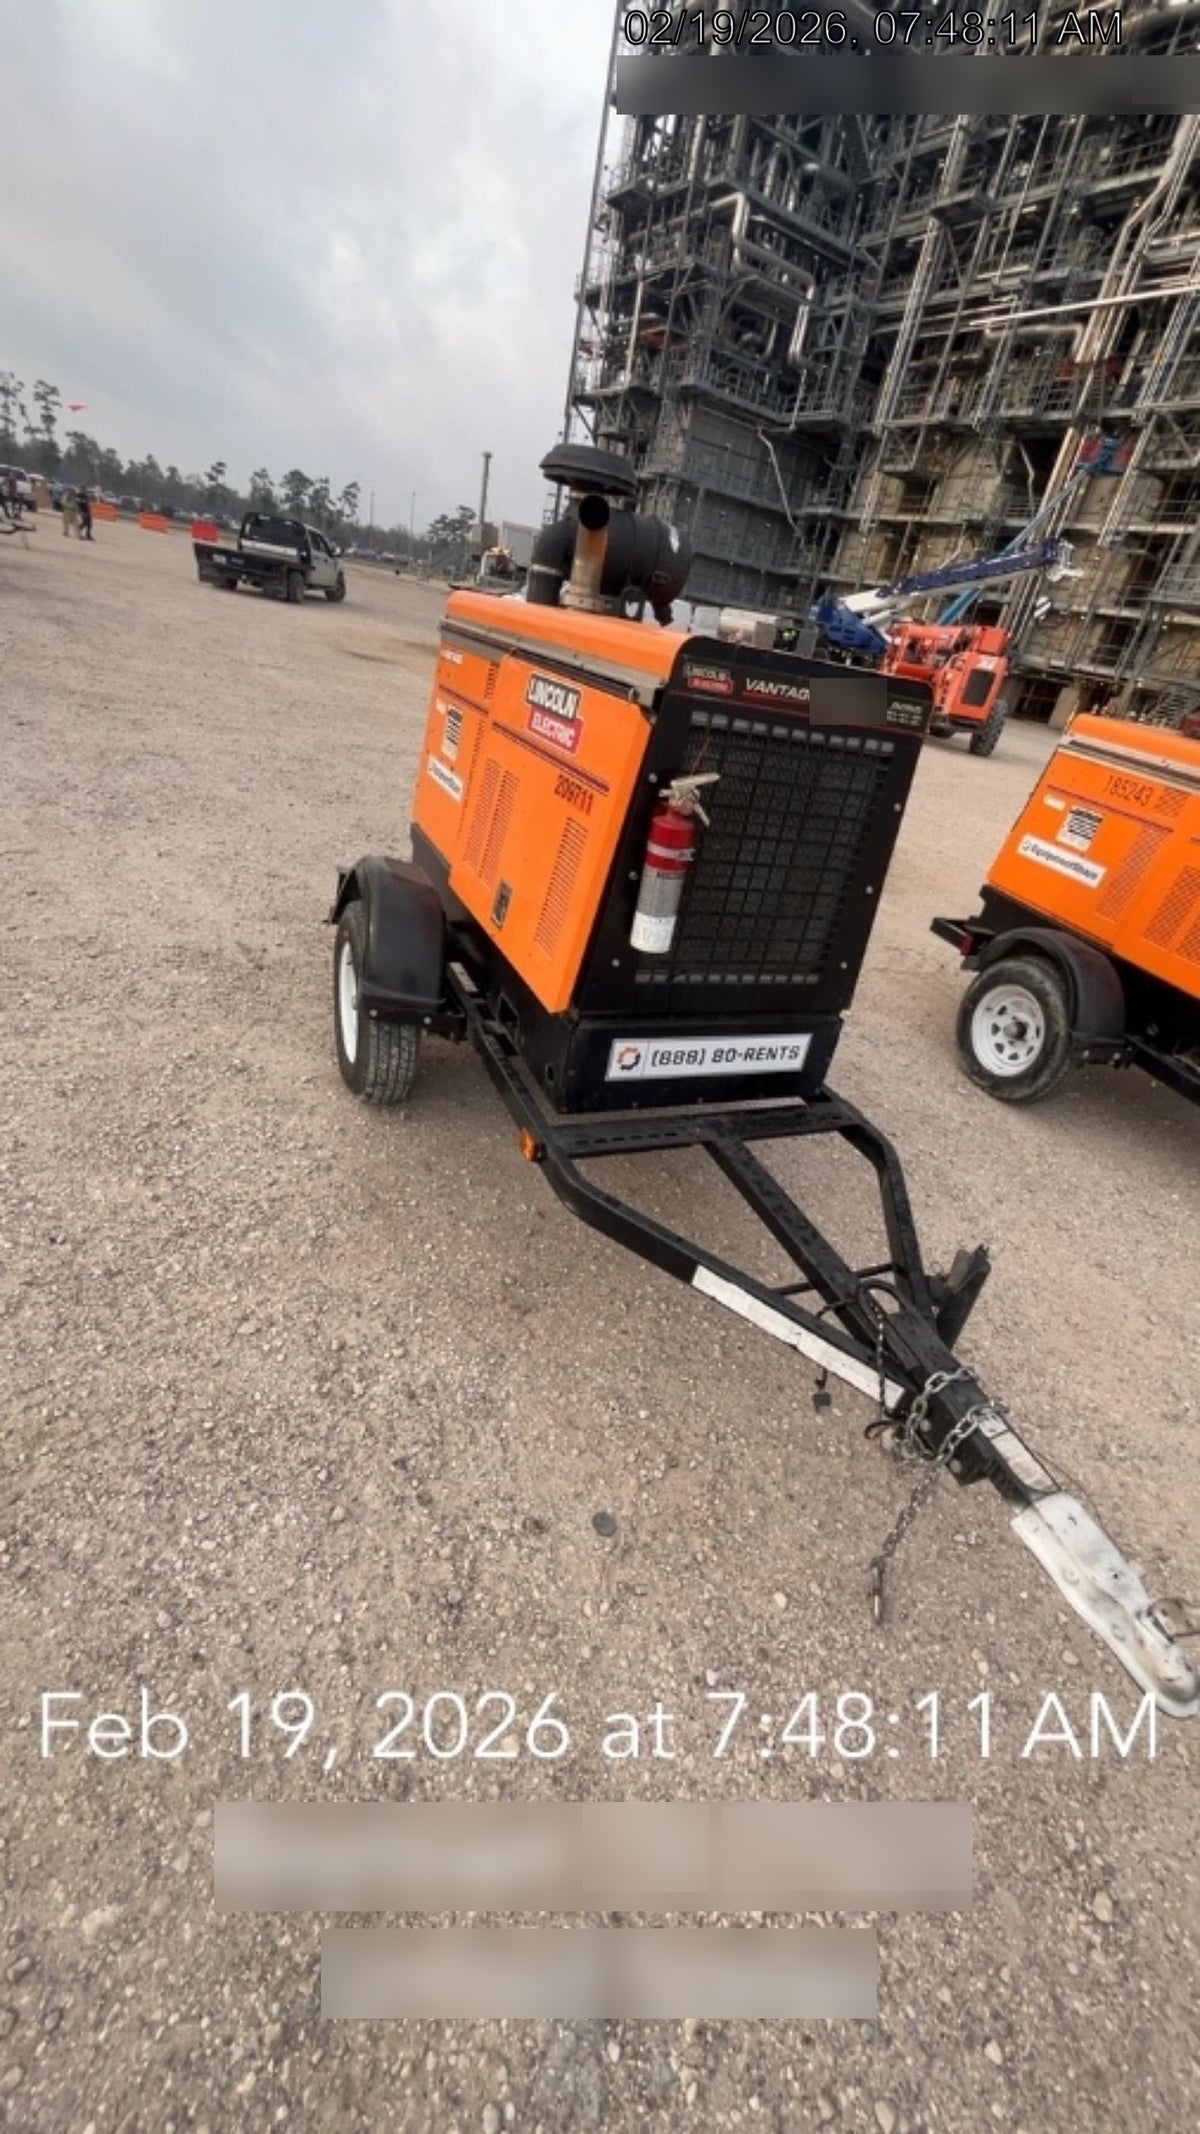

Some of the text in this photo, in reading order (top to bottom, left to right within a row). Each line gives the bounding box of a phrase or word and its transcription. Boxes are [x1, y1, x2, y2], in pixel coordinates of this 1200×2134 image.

[528, 676, 579, 721] LINCOLN
[745, 678, 810, 700] VANTAG
[530, 710, 576, 750] ELECTRIC
[1102, 774, 1154, 808] 185243
[651, 1045, 800, 1068] (888) 80-RENTS
